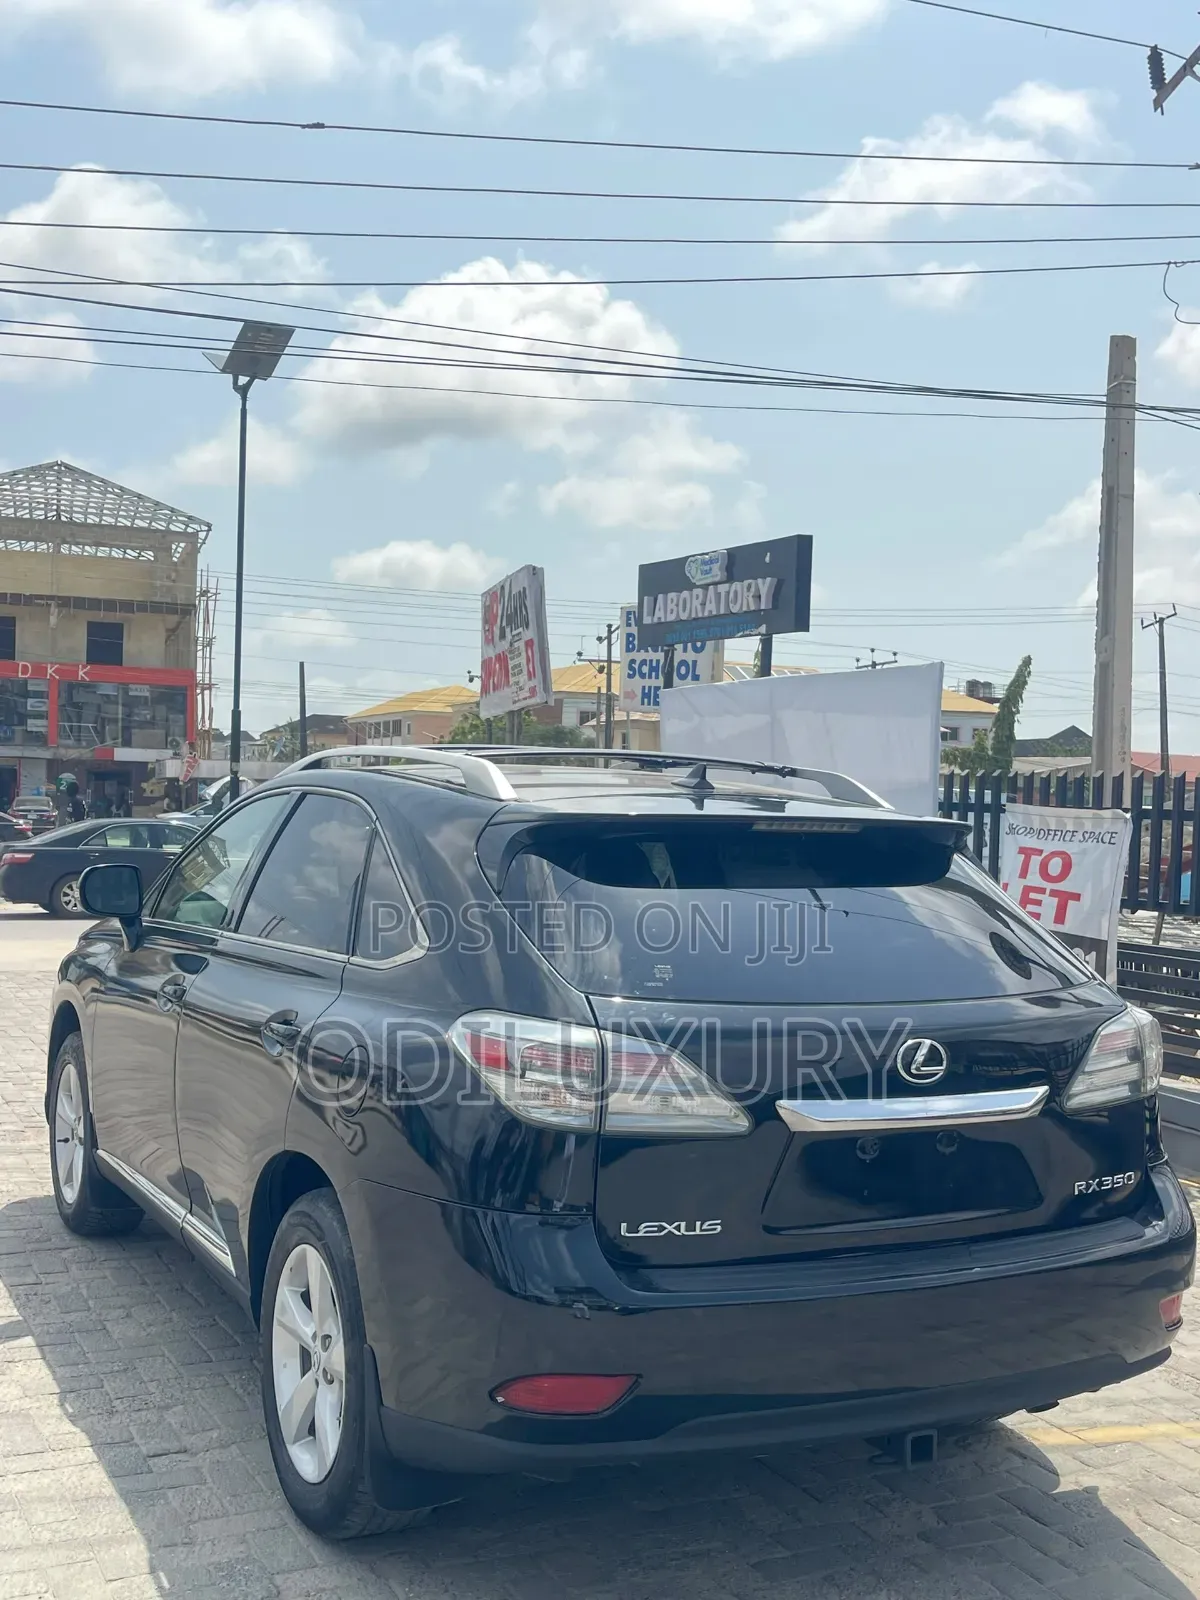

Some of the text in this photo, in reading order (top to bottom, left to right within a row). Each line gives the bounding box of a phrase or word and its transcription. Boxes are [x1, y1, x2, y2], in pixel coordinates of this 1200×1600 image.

[643, 577, 777, 625] LABORATORY
[627, 658, 700, 681] SCHOL
[1079, 829, 1118, 845] SPACE
[1017, 846, 1073, 884] TO
[1002, 882, 1081, 926] ET
[1074, 1171, 1135, 1195] RX350
[620, 1220, 722, 1237] LEXUS
